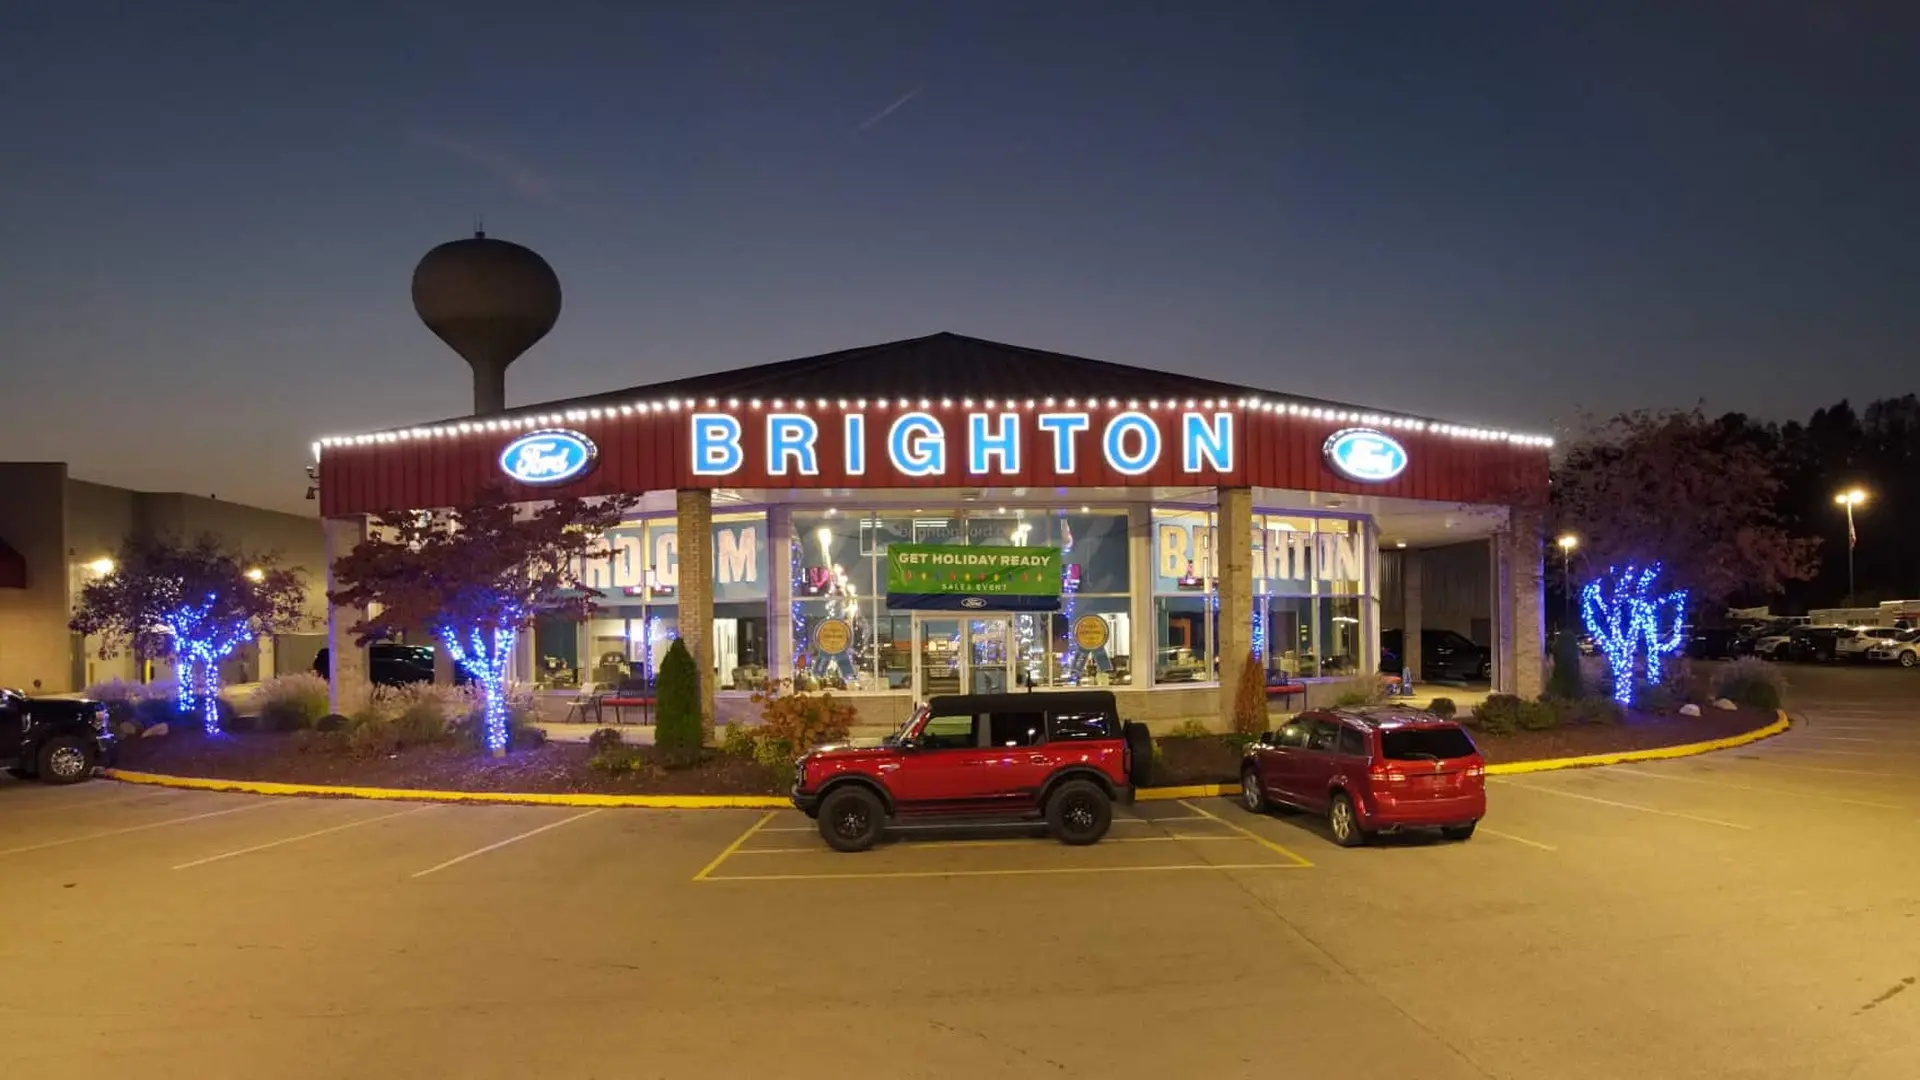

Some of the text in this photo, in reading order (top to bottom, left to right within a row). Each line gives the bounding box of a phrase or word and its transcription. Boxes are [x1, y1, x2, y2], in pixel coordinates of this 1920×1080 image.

[515, 441, 571, 477] Ford
[692, 412, 1234, 476] BRIGHTON
[899, 552, 1051, 567] GET HOLIDAY READY
[1158, 523, 1361, 582] BRGHTON
